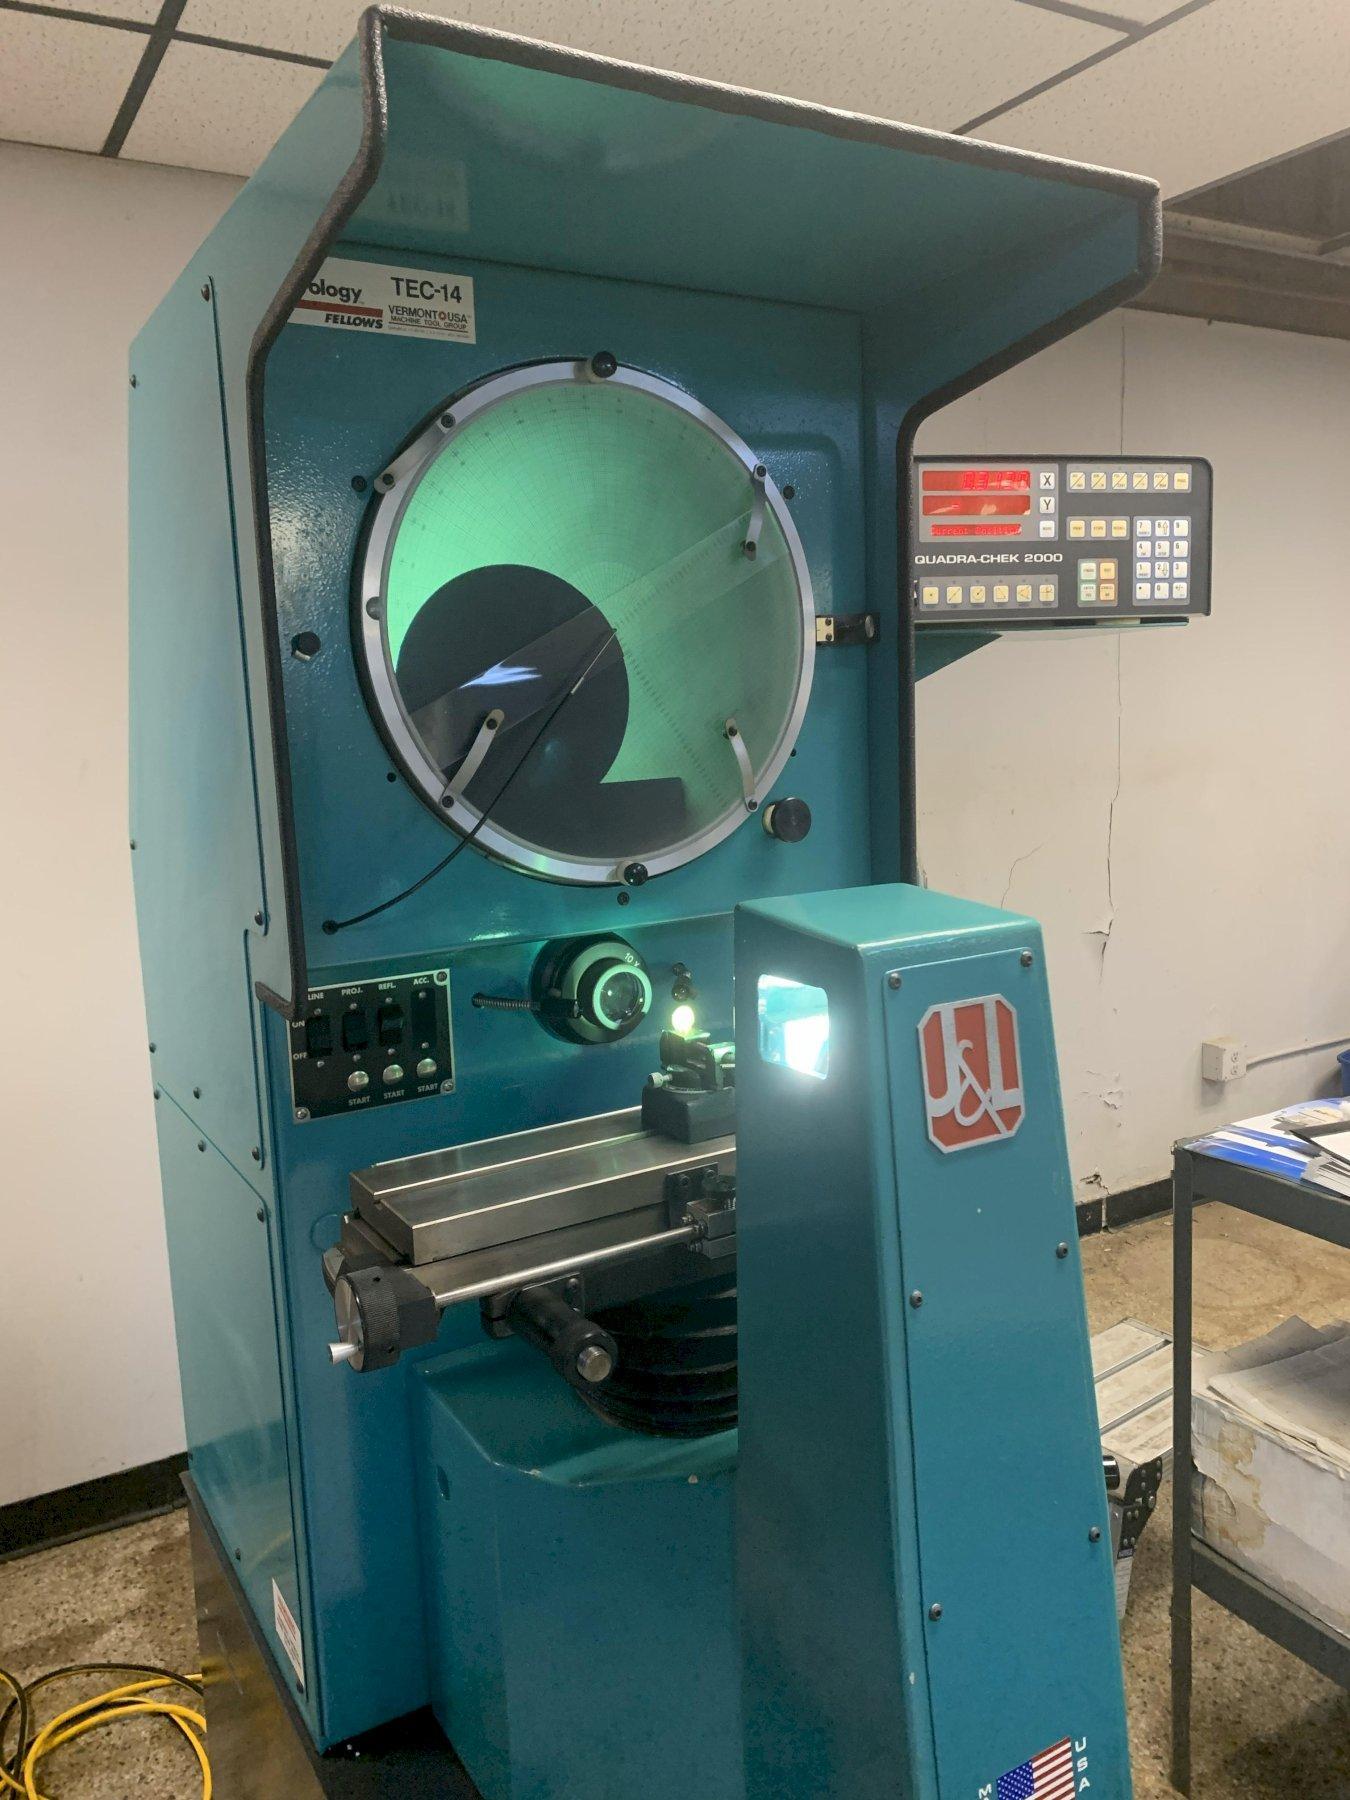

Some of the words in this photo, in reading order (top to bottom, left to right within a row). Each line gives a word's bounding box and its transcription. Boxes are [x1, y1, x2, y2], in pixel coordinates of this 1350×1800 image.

[390, 276, 462, 304] TEC-14
[388, 305, 438, 320] VERMONT
[447, 312, 468, 324] USA
[324, 313, 383, 329] FELLOWS
[391, 315, 421, 325] MACHINE
[424, 320, 442, 328] TOOL
[444, 322, 467, 330] GROUP
[1043, 475, 1052, 487] X
[1043, 499, 1052, 511] Y
[914, 553, 1020, 565] QUADRA-CHEK
[1024, 553, 1063, 563] 2000
[625, 953, 634, 963] 10
[413, 976, 430, 985] ACC.
[341, 987, 363, 996] PROJ.
[378, 982, 397, 991] REFL.
[307, 992, 324, 1001] LINE
[291, 1020, 305, 1028] ON
[292, 1052, 308, 1060] OFF
[417, 1083, 438, 1093] START
[383, 1089, 405, 1100] START
[348, 1095, 371, 1106] START
